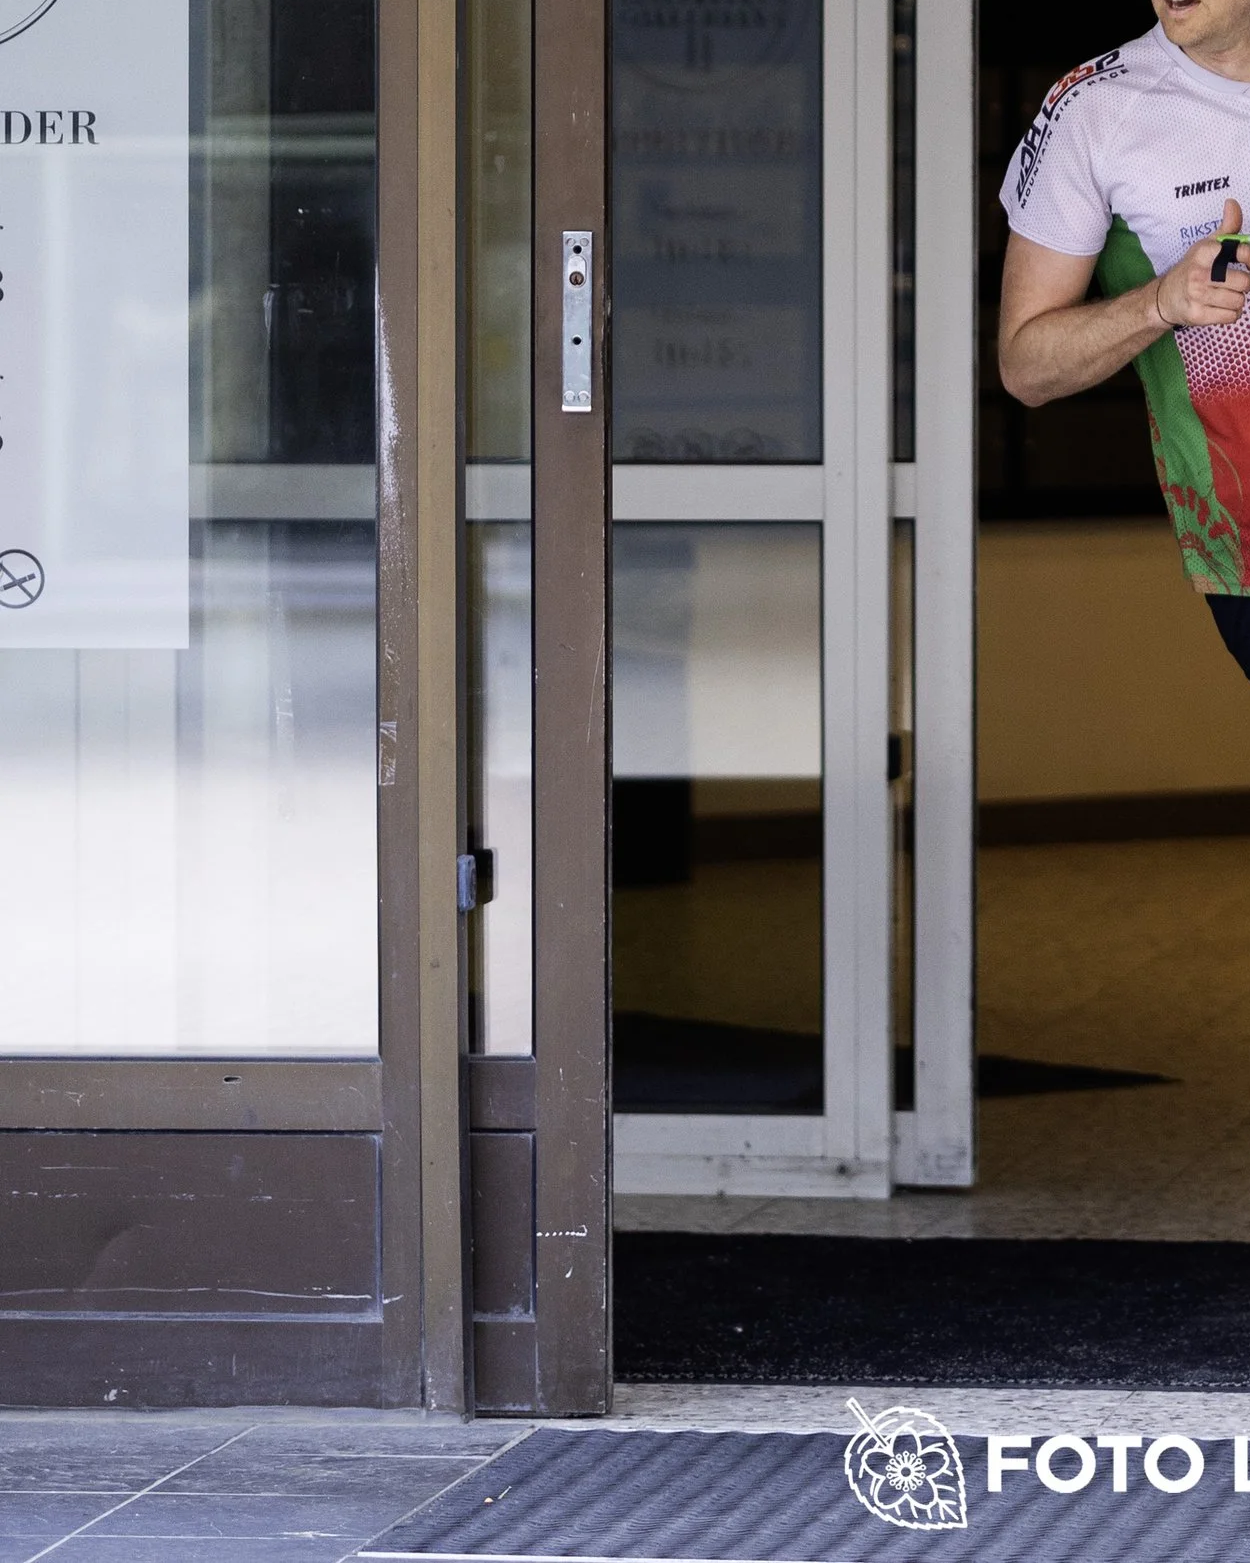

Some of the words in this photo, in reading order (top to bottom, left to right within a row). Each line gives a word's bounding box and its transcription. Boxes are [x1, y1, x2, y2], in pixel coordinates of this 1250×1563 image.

[1020, 129, 1053, 210] MOUNTAIN
[1054, 89, 1081, 122] BIKE
[1087, 68, 1130, 86] RACE
[1174, 176, 1231, 199] TRIMTEX
[1180, 219, 1224, 239] RIKST
